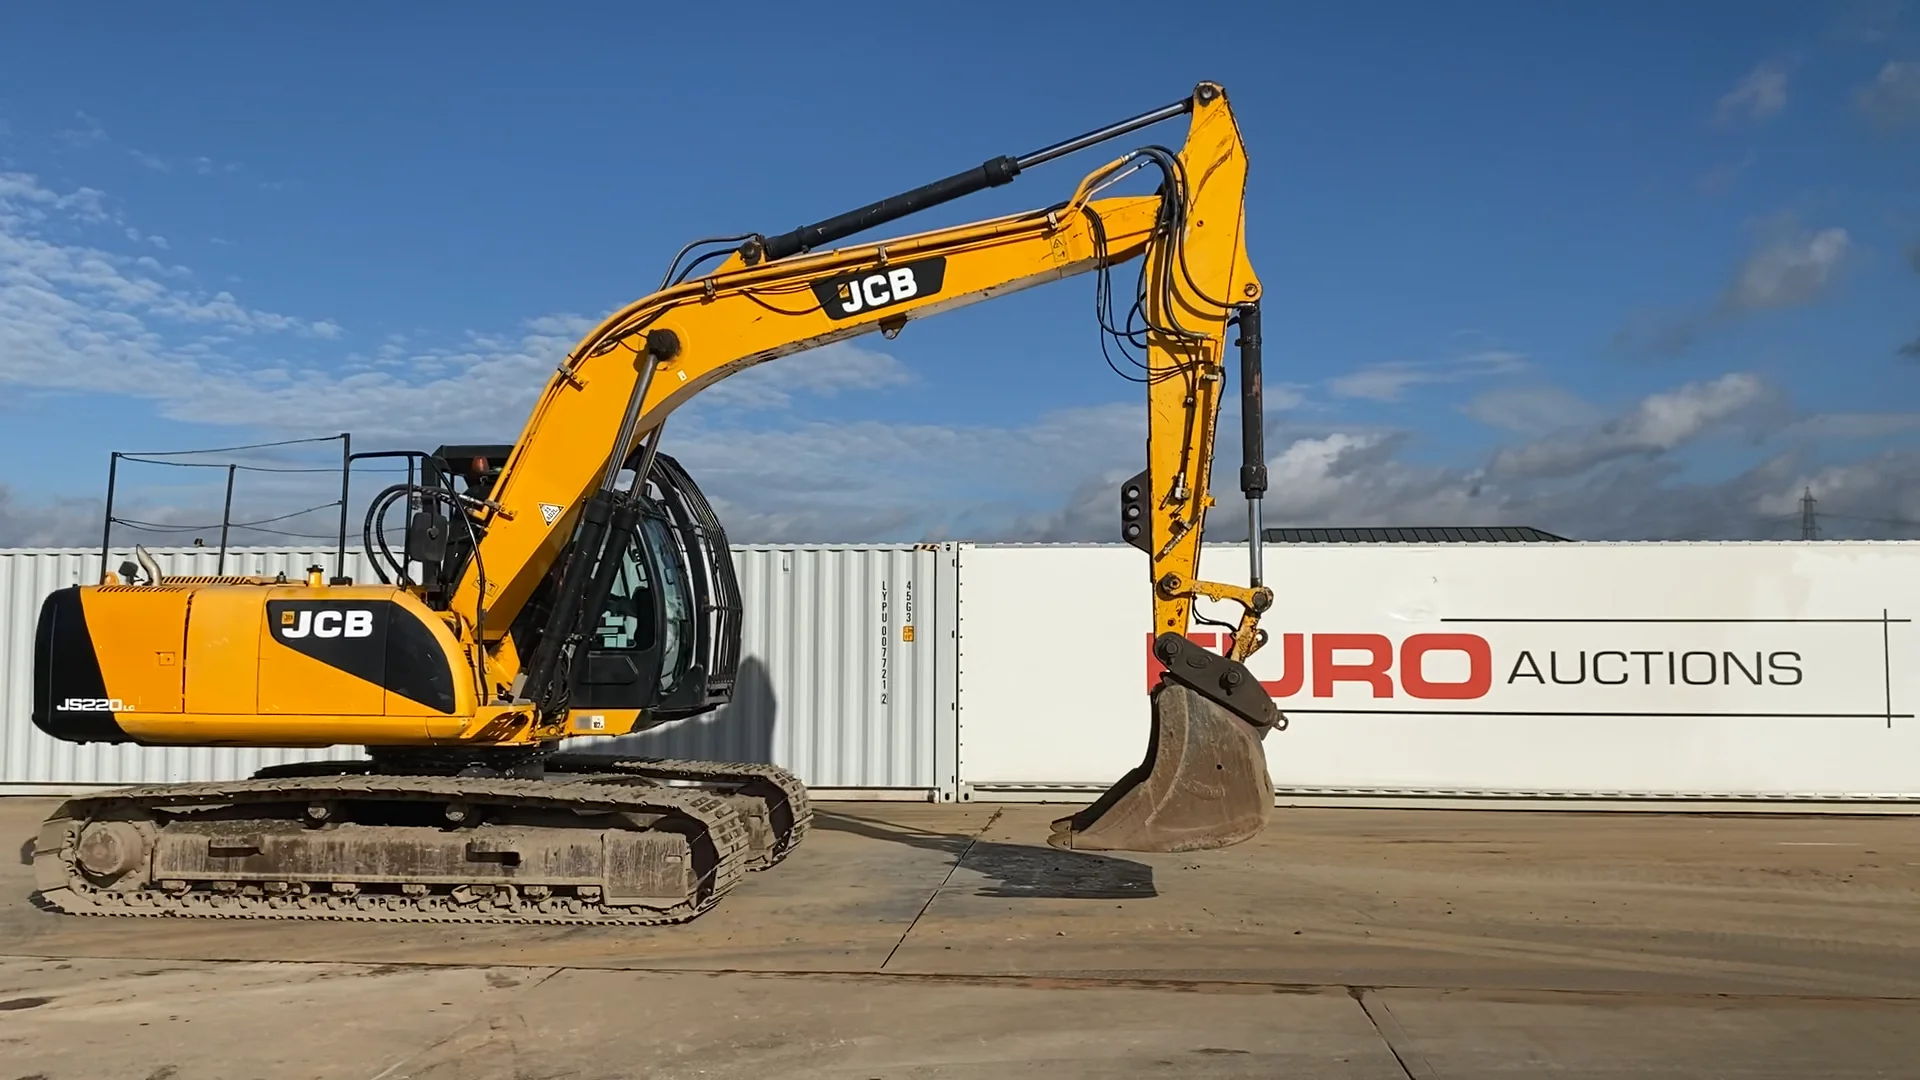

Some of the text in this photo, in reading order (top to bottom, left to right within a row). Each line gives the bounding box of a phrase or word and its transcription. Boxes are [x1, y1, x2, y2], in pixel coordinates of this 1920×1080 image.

[841, 267, 917, 312] JCB
[281, 610, 373, 638] JCB
[1507, 650, 1804, 687] AUCTIONS
[56, 698, 123, 712] JS220
